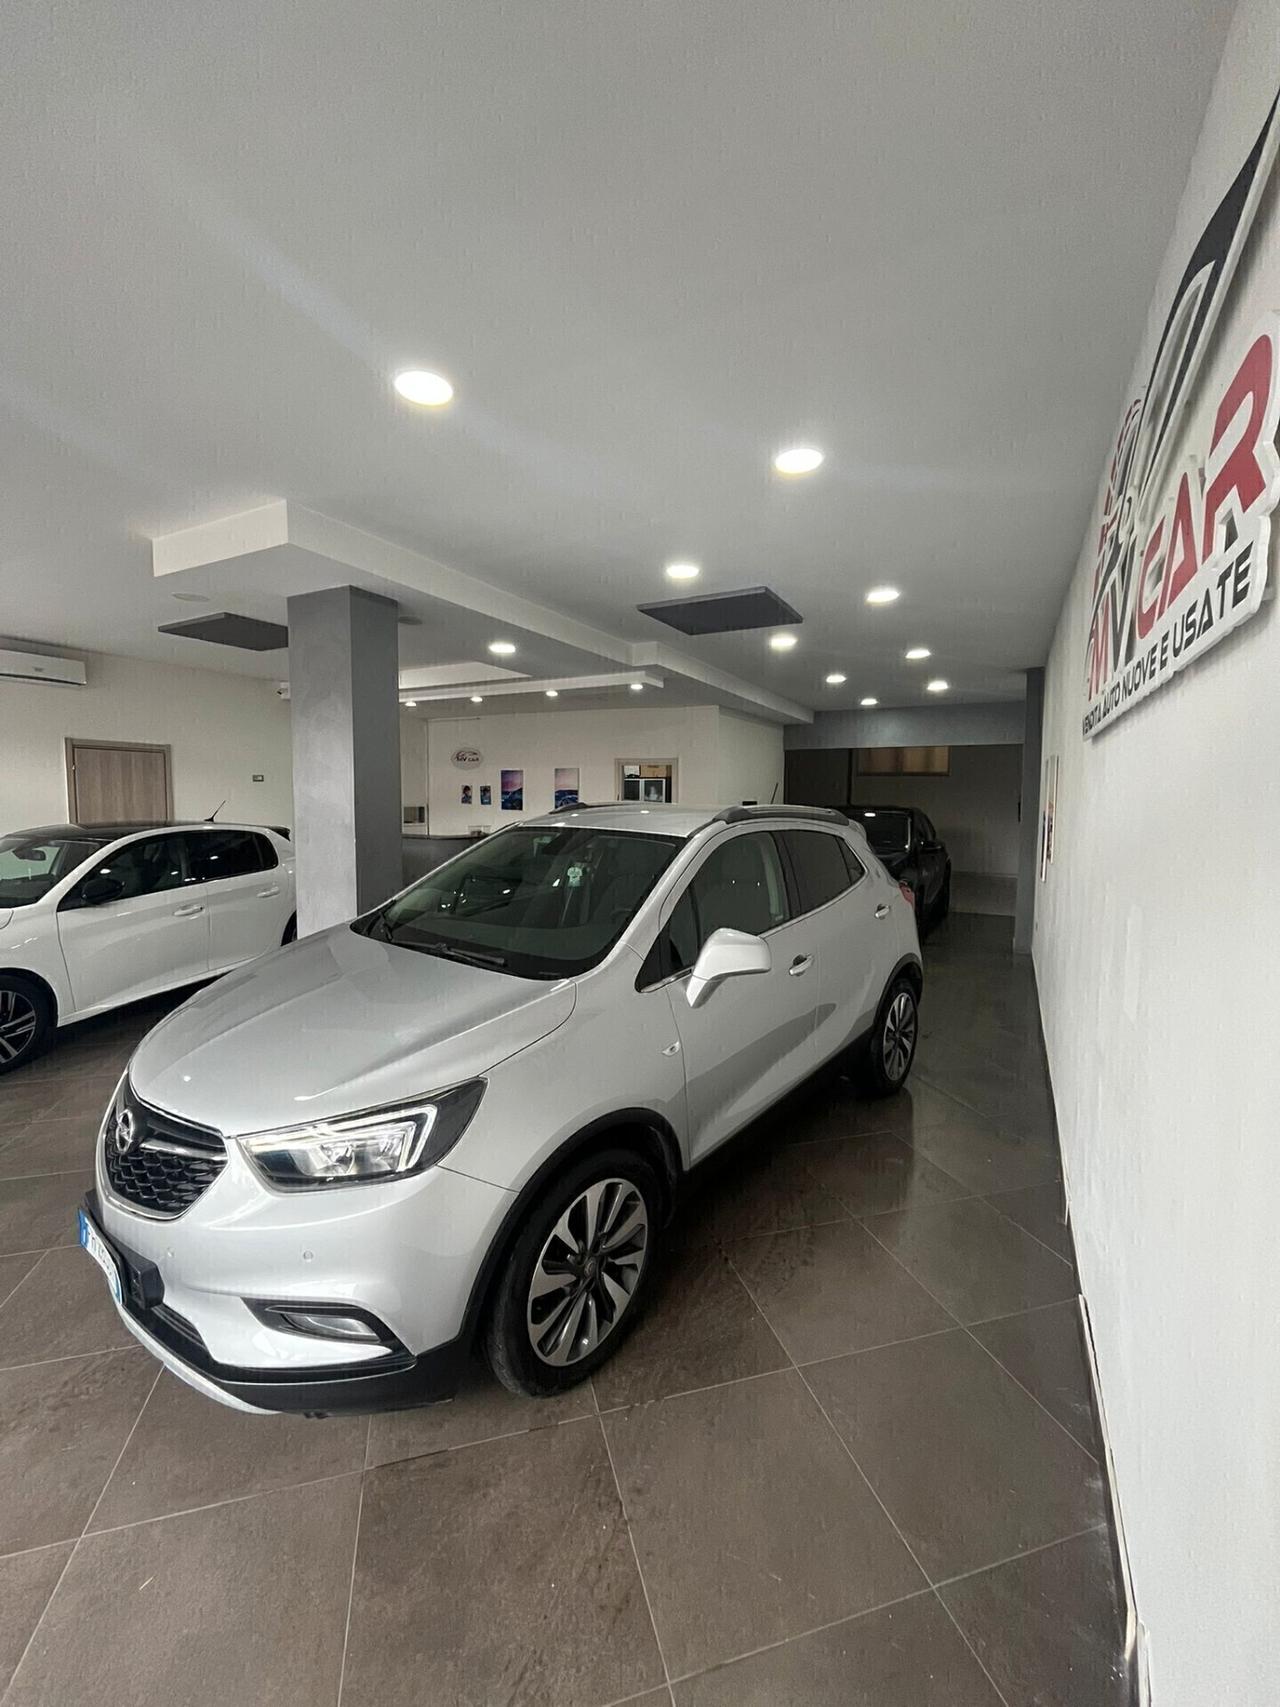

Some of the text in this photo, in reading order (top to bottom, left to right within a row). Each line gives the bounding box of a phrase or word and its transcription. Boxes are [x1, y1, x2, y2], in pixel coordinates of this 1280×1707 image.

[1102, 681, 1120, 718] AUTO
[1121, 642, 1158, 702] NUOVE
[1160, 630, 1170, 671] E
[1172, 539, 1255, 658] USATE
